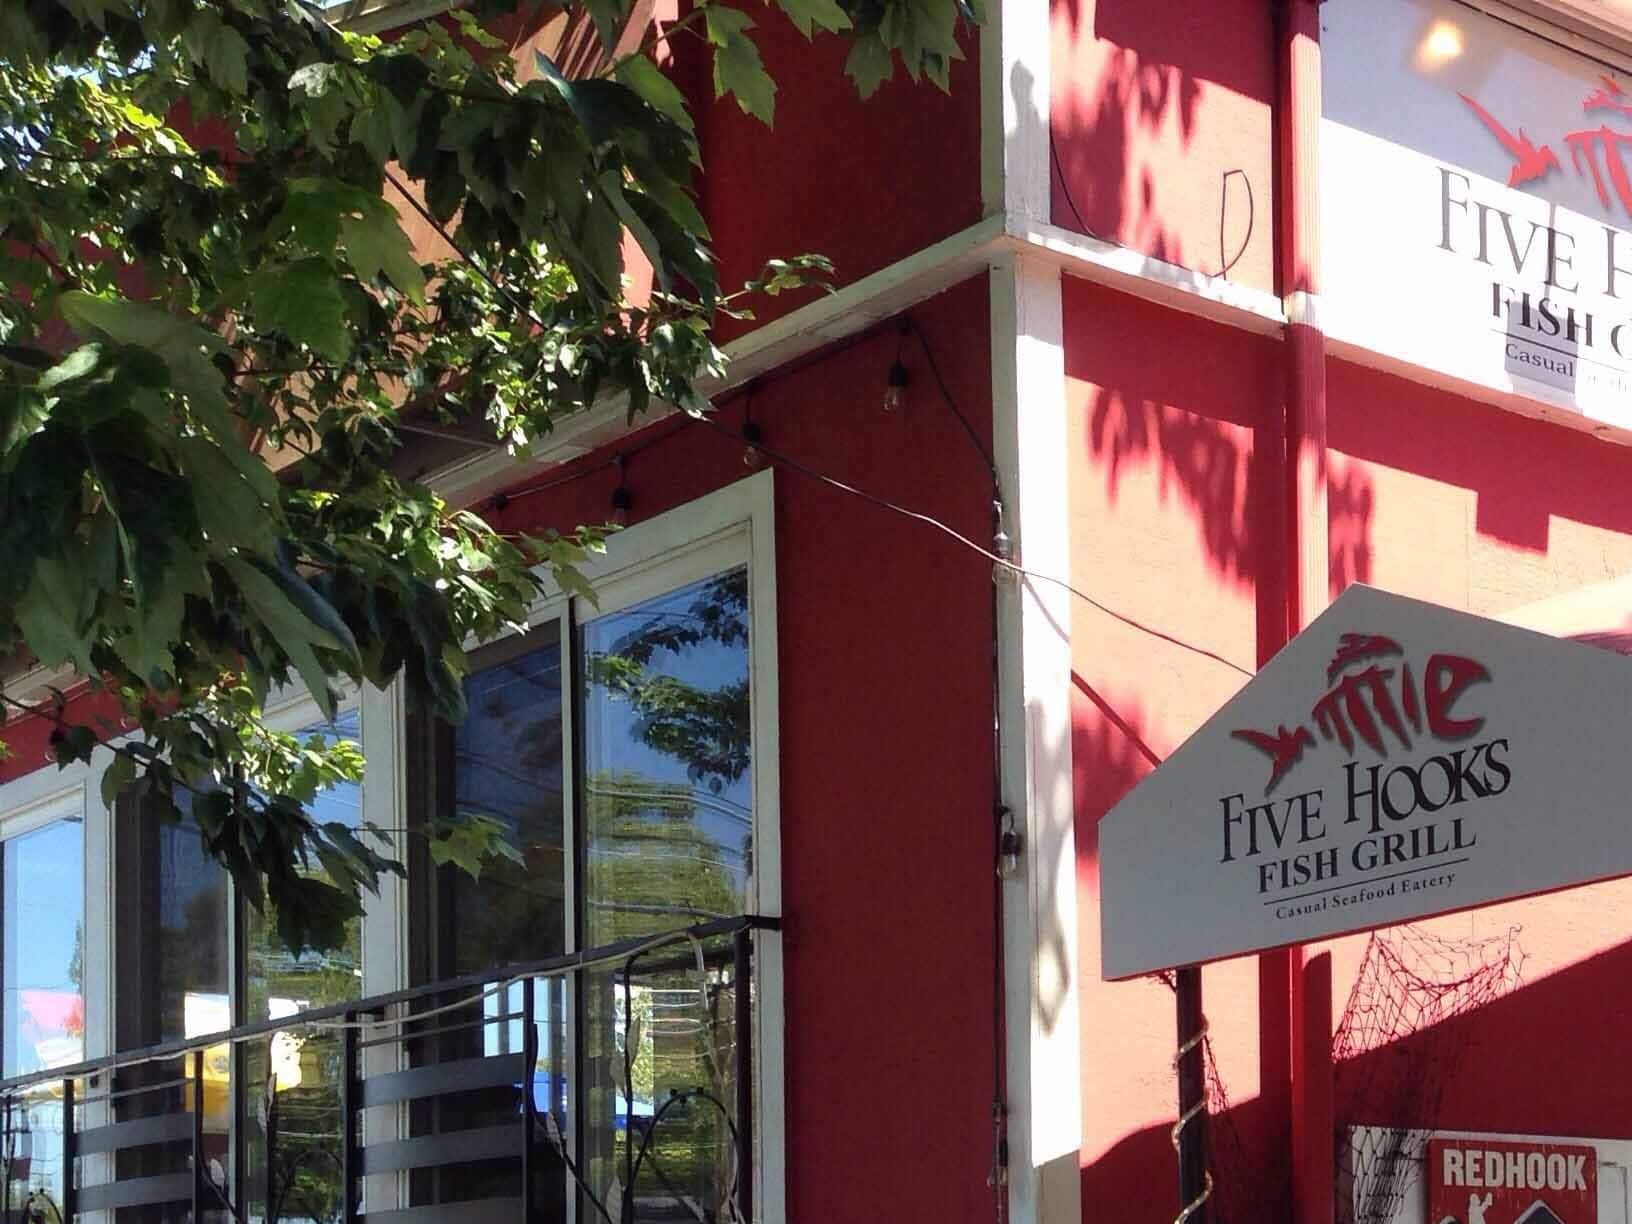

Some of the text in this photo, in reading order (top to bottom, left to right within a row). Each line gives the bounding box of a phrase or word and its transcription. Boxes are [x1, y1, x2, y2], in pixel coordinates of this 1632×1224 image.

[1436, 166, 1579, 296] FIVE
[1492, 282, 1594, 348] FISH
[1505, 342, 1575, 378] Casual
[1219, 738, 1512, 864] FIVE HOOKS
[1256, 818, 1478, 894] FISH GRILL
[1276, 872, 1456, 920] Casual Seafood Eatery
[1442, 1147, 1588, 1191] REDHOOK
